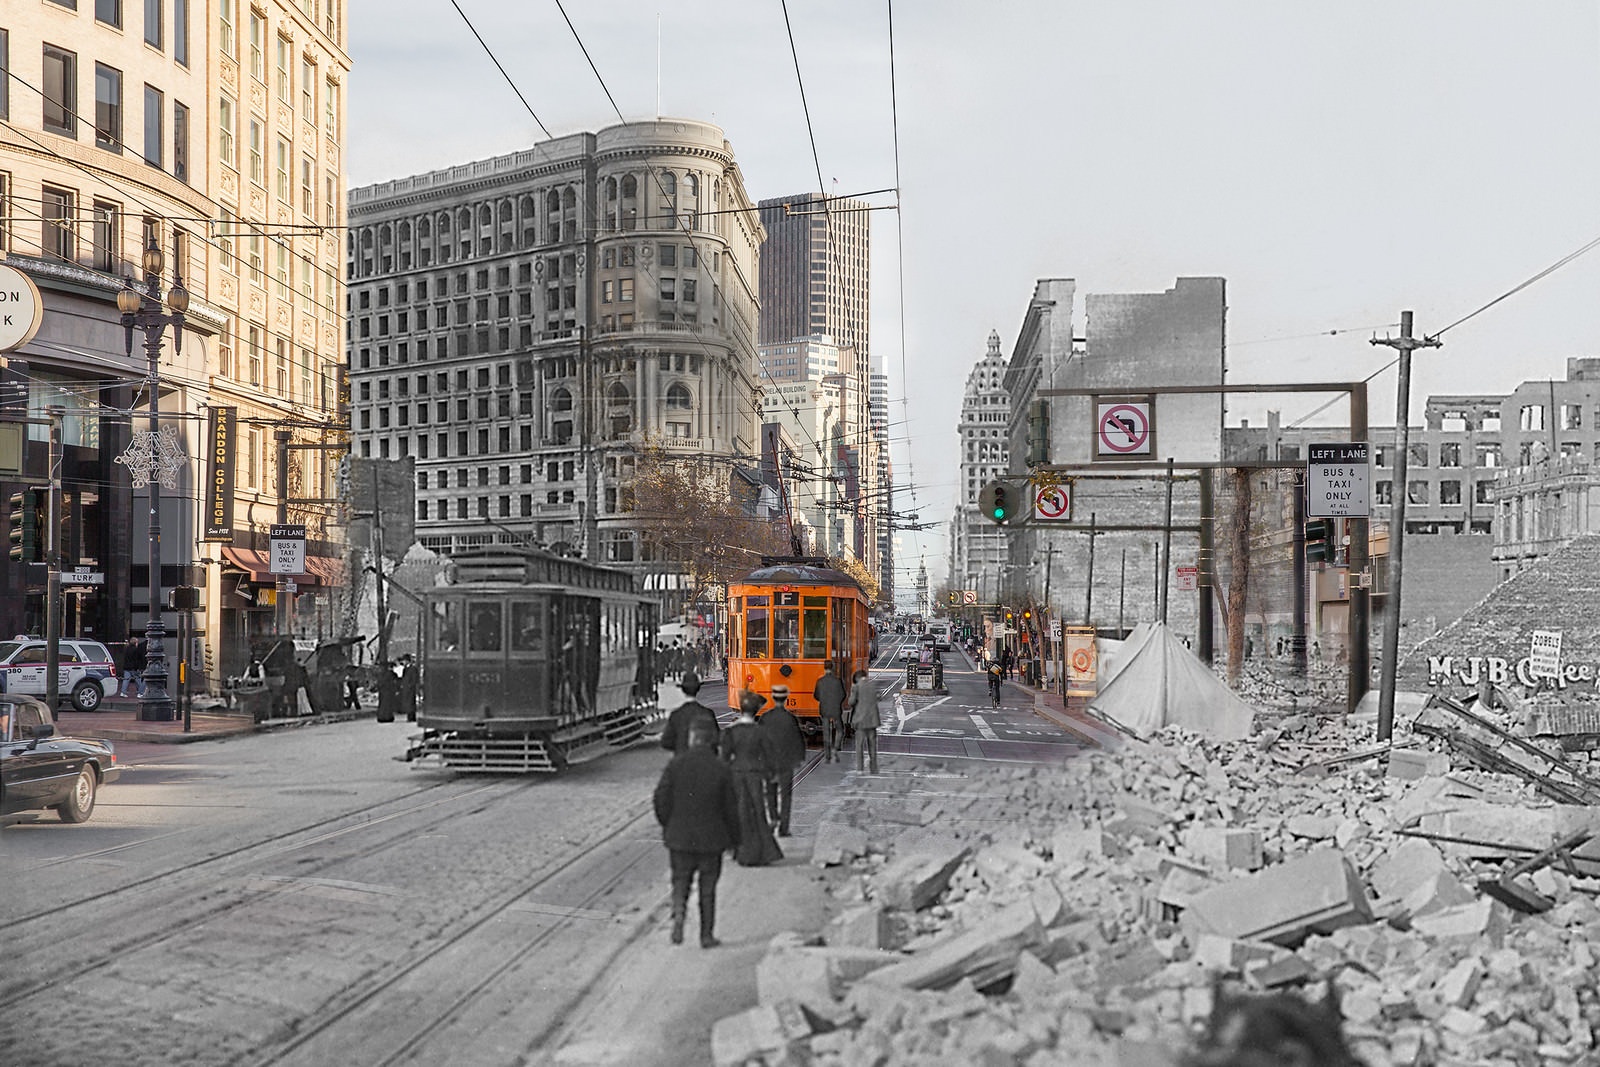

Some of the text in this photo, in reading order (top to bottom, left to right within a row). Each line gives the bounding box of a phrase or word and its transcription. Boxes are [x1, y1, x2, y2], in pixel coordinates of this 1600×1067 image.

[1311, 449, 1367, 459] LEFT LANE
[214, 408, 227, 525] BRANDON COLLEGE
[1323, 468, 1355, 477] BUS &
[1328, 480, 1351, 488] TAXI
[1325, 492, 1352, 501] ONLY
[71, 574, 94, 582] TURK
[780, 592, 793, 605] F
